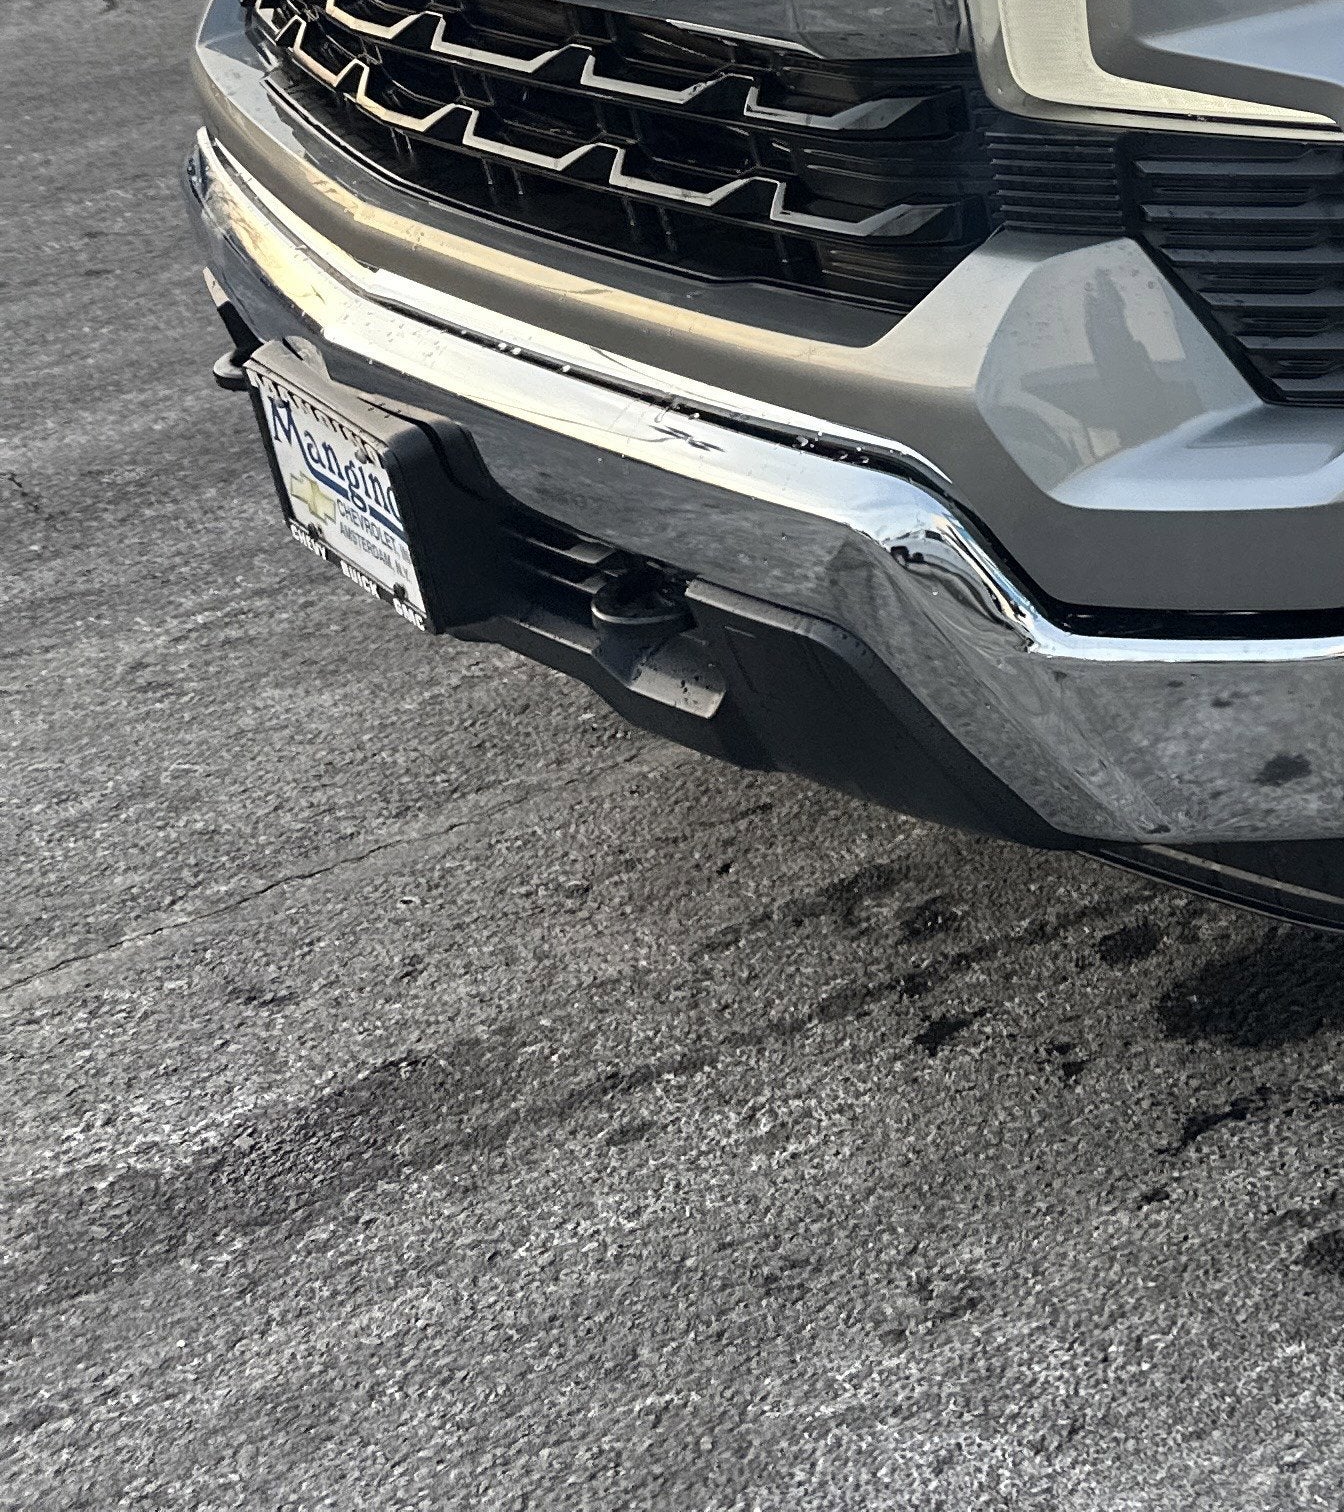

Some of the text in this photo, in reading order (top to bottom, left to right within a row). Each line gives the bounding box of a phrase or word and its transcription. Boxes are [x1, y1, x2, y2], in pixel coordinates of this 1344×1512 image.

[291, 524, 425, 631] CHEVY BUICK GMC
